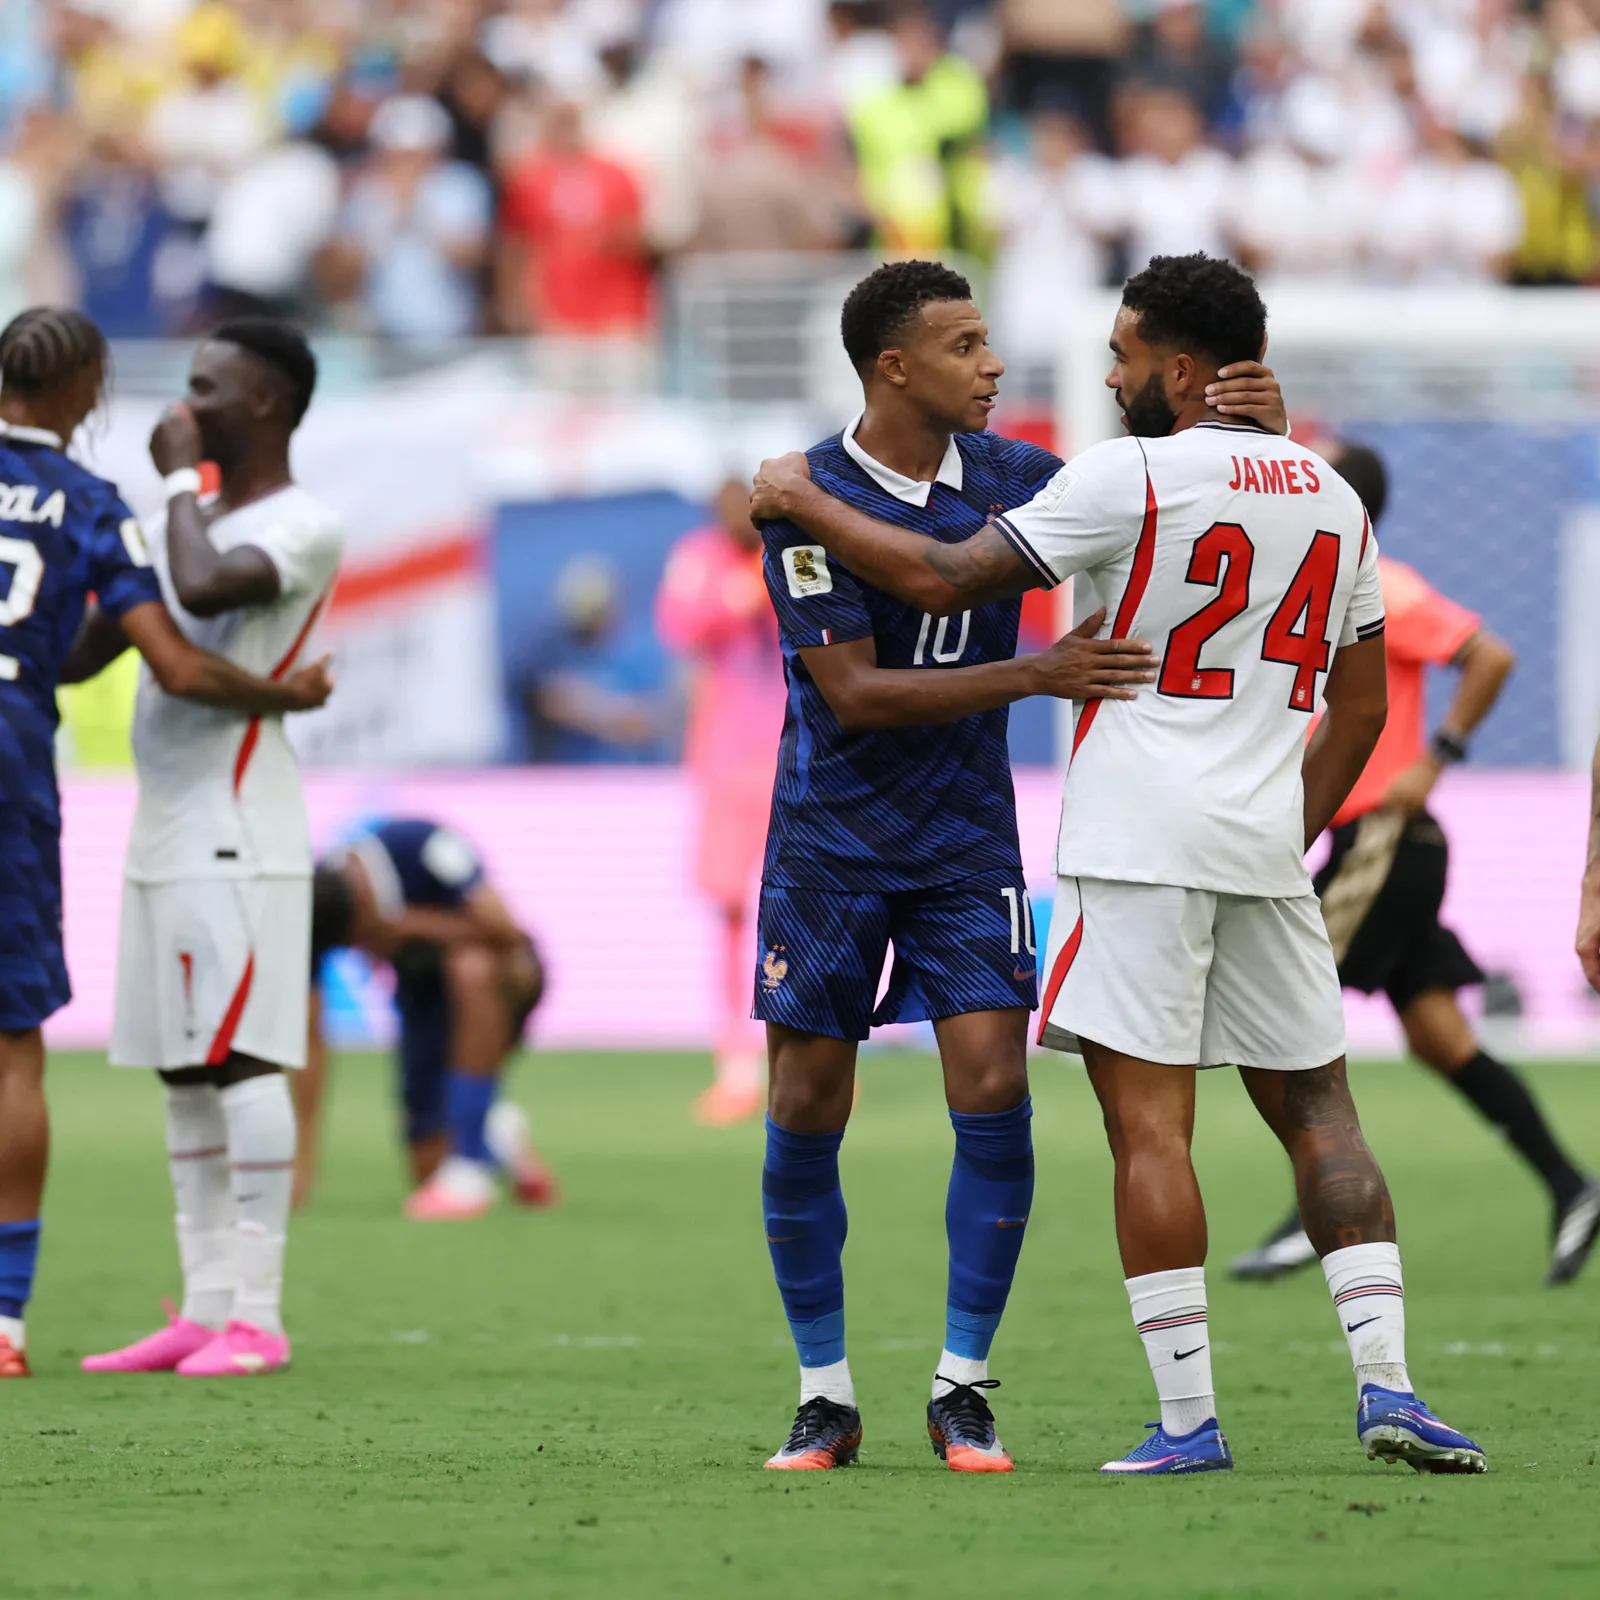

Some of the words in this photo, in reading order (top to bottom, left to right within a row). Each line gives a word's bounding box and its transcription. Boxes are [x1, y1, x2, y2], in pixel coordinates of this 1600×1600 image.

[1228, 455, 1320, 494] JAMES
[913, 609, 971, 665] 10
[1157, 522, 1341, 713] 24
